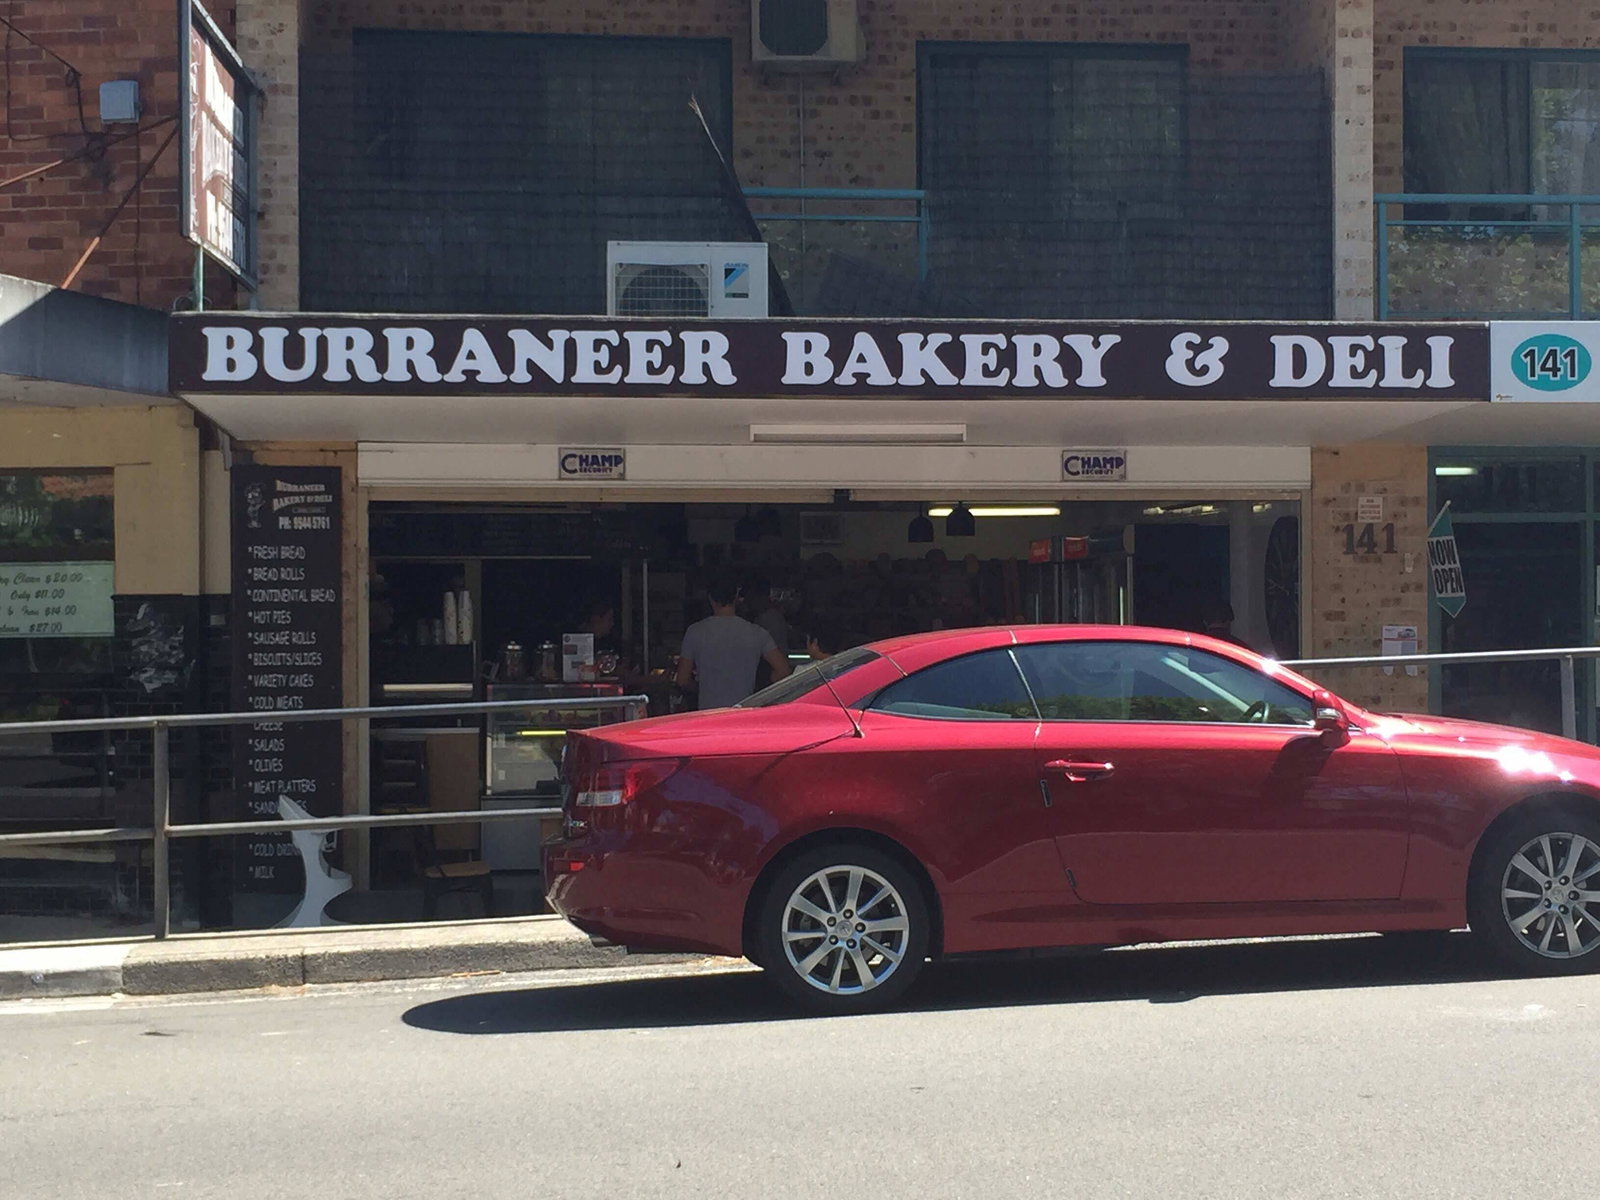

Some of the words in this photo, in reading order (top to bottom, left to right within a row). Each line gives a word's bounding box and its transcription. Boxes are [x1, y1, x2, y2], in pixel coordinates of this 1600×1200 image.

[202, 327, 738, 386] BURRANEER
[781, 331, 1122, 388] BAKERY
[1165, 331, 1229, 387] &
[1269, 334, 1456, 389] DELI
[1521, 346, 1578, 380] 141
[561, 453, 624, 475] CHAMP
[1064, 455, 1124, 476] CHAMP
[272, 496, 305, 512] BAKERY
[314, 495, 333, 503] DELI
[1342, 522, 1398, 554] 141
[253, 546, 279, 559] FRESH
[280, 546, 306, 559] BREAD
[1427, 539, 1457, 566] NOW
[253, 567, 279, 581] BREAD
[280, 567, 305, 581] ROLLS
[1434, 567, 1463, 594] OPEN
[252, 588, 308, 602] CONTINENTAL
[310, 588, 336, 602] BREAD
[253, 610, 271, 624] HOT
[272, 610, 292, 624] PIES
[253, 631, 290, 645] SAUSAGE
[291, 631, 317, 645] ROLLS
[253, 674, 288, 688] VARIETY
[289, 674, 315, 688] CAKES
[254, 696, 275, 710] COLD
[276, 696, 304, 710] MEATS
[254, 739, 285, 752] SALADS
[254, 758, 284, 772] OLIVES
[277, 778, 317, 793] PLATTERS
[254, 844, 275, 856] COLD
[254, 866, 275, 879] MILK
